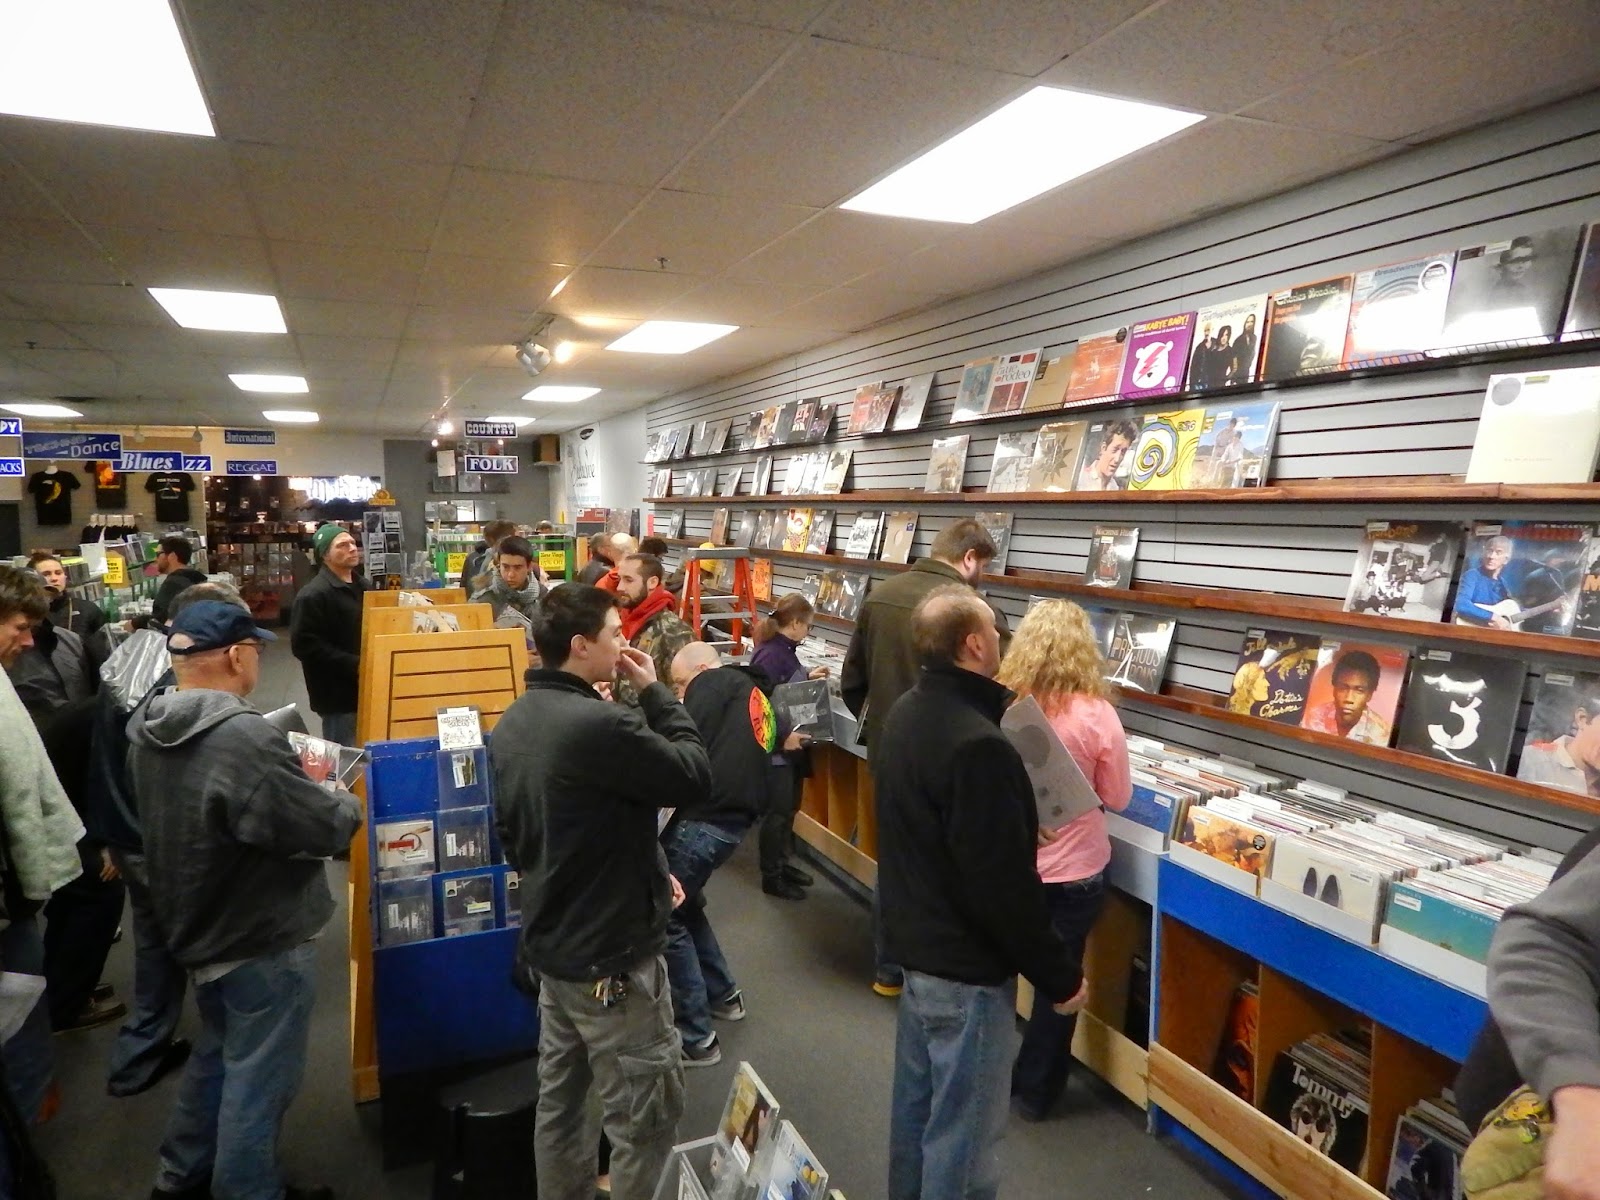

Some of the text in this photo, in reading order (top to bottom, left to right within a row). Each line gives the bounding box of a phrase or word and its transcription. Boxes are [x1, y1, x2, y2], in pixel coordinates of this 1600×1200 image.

[466, 423, 515, 434] COUNTRY
[70, 440, 120, 458] Dance
[120, 453, 174, 470] Blues
[228, 463, 276, 472] REGGAE
[470, 458, 515, 471] FOLK
[1259, 703, 1303, 718] Charms
[1291, 1061, 1356, 1119] Tommy
